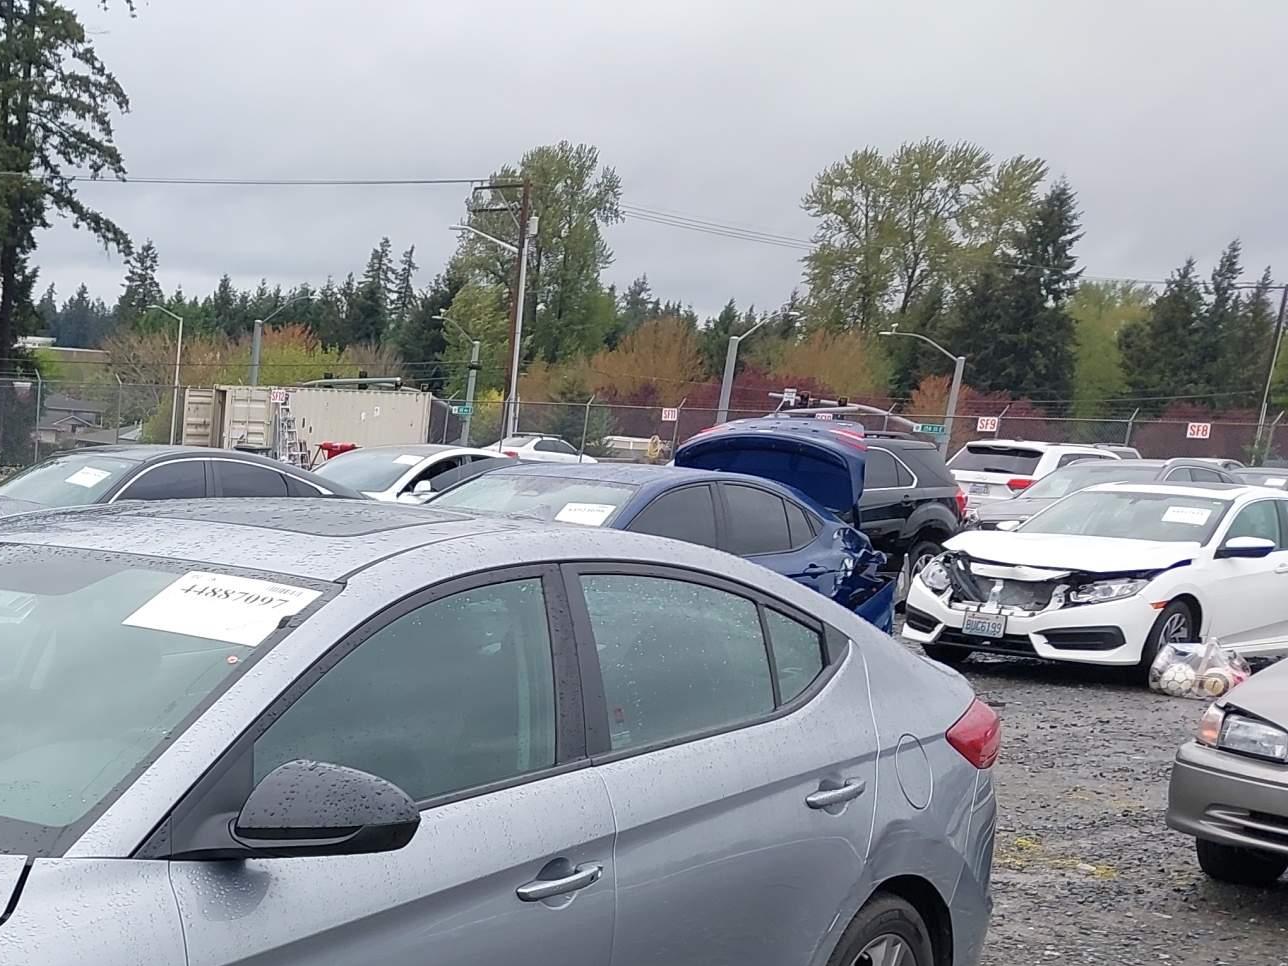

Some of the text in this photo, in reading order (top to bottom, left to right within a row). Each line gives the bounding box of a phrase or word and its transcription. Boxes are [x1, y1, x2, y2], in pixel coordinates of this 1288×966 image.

[663, 410, 676, 419] SF11
[979, 418, 997, 430] SF9
[1189, 424, 1209, 436] SF8
[181, 584, 289, 608] 44887097
